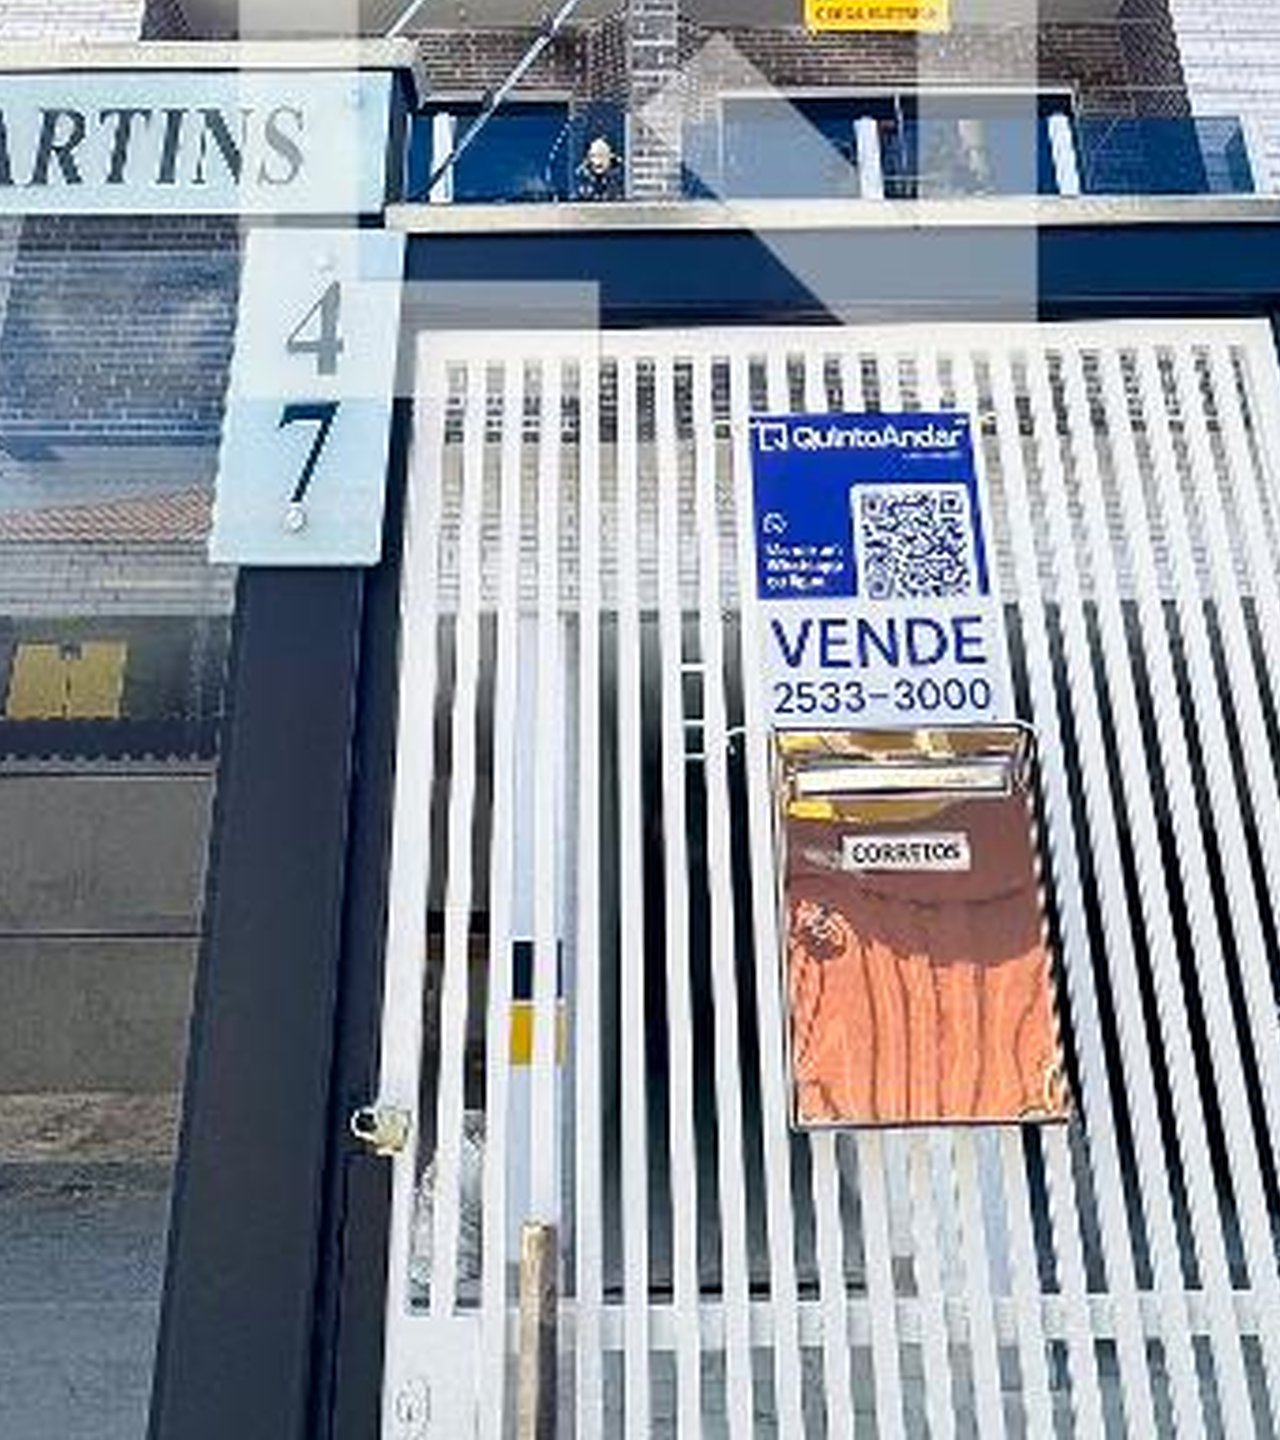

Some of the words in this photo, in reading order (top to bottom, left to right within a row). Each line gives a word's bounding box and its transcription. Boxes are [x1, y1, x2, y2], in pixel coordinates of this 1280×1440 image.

[793, 424, 963, 450] QuintoAndar
[771, 616, 987, 667] VENDE
[773, 678, 991, 714] 2533-3000
[852, 842, 961, 863] CORREIOS
